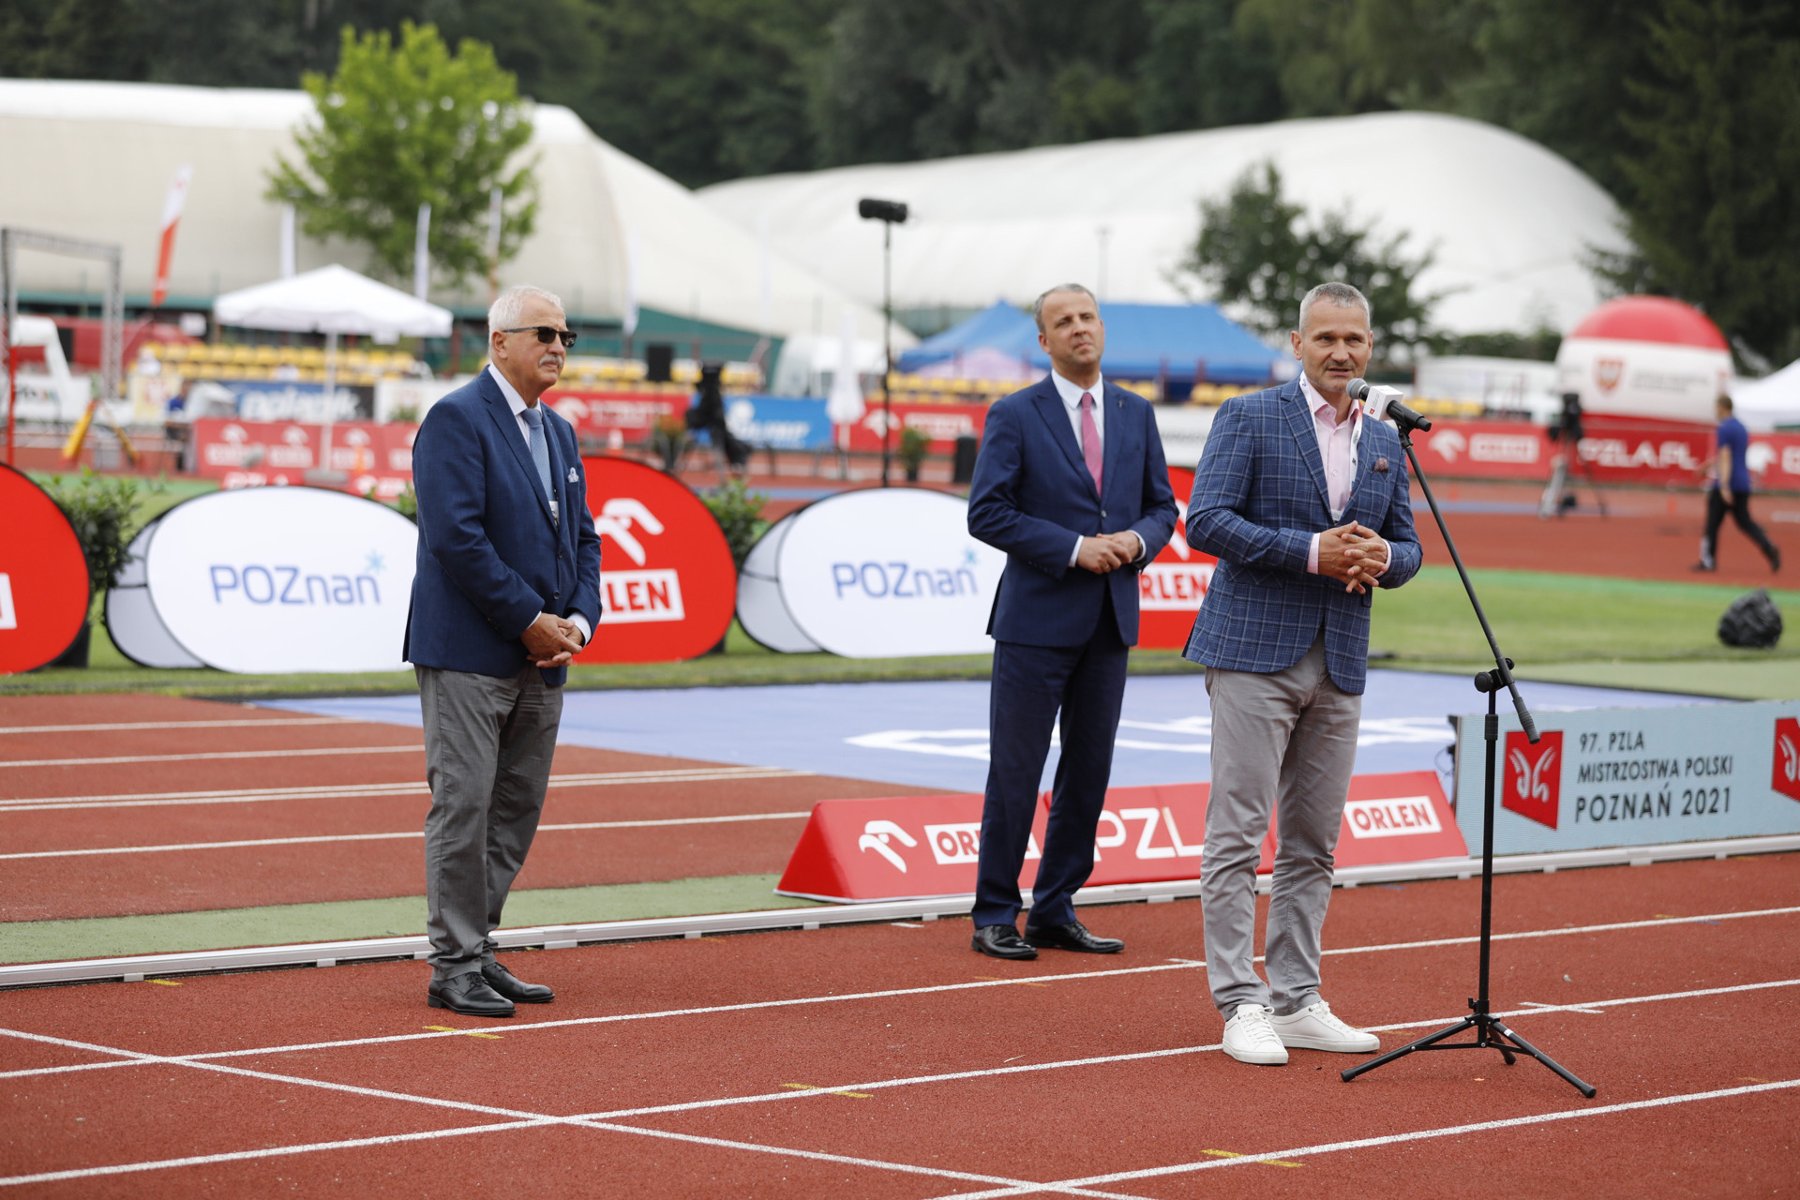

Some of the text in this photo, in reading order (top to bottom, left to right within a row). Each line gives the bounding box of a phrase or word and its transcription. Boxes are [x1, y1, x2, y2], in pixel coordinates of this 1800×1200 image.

[603, 580, 671, 612] LEN
[1139, 572, 1208, 600] RLEN
[1580, 731, 1645, 752] 97. PZLA
[1578, 755, 1733, 783] MISTRZOSTWA POLSKI
[1352, 802, 1432, 831] ORLEN
[1576, 781, 1730, 823] POZNAŃ 2021
[1094, 807, 1205, 861] PZL
